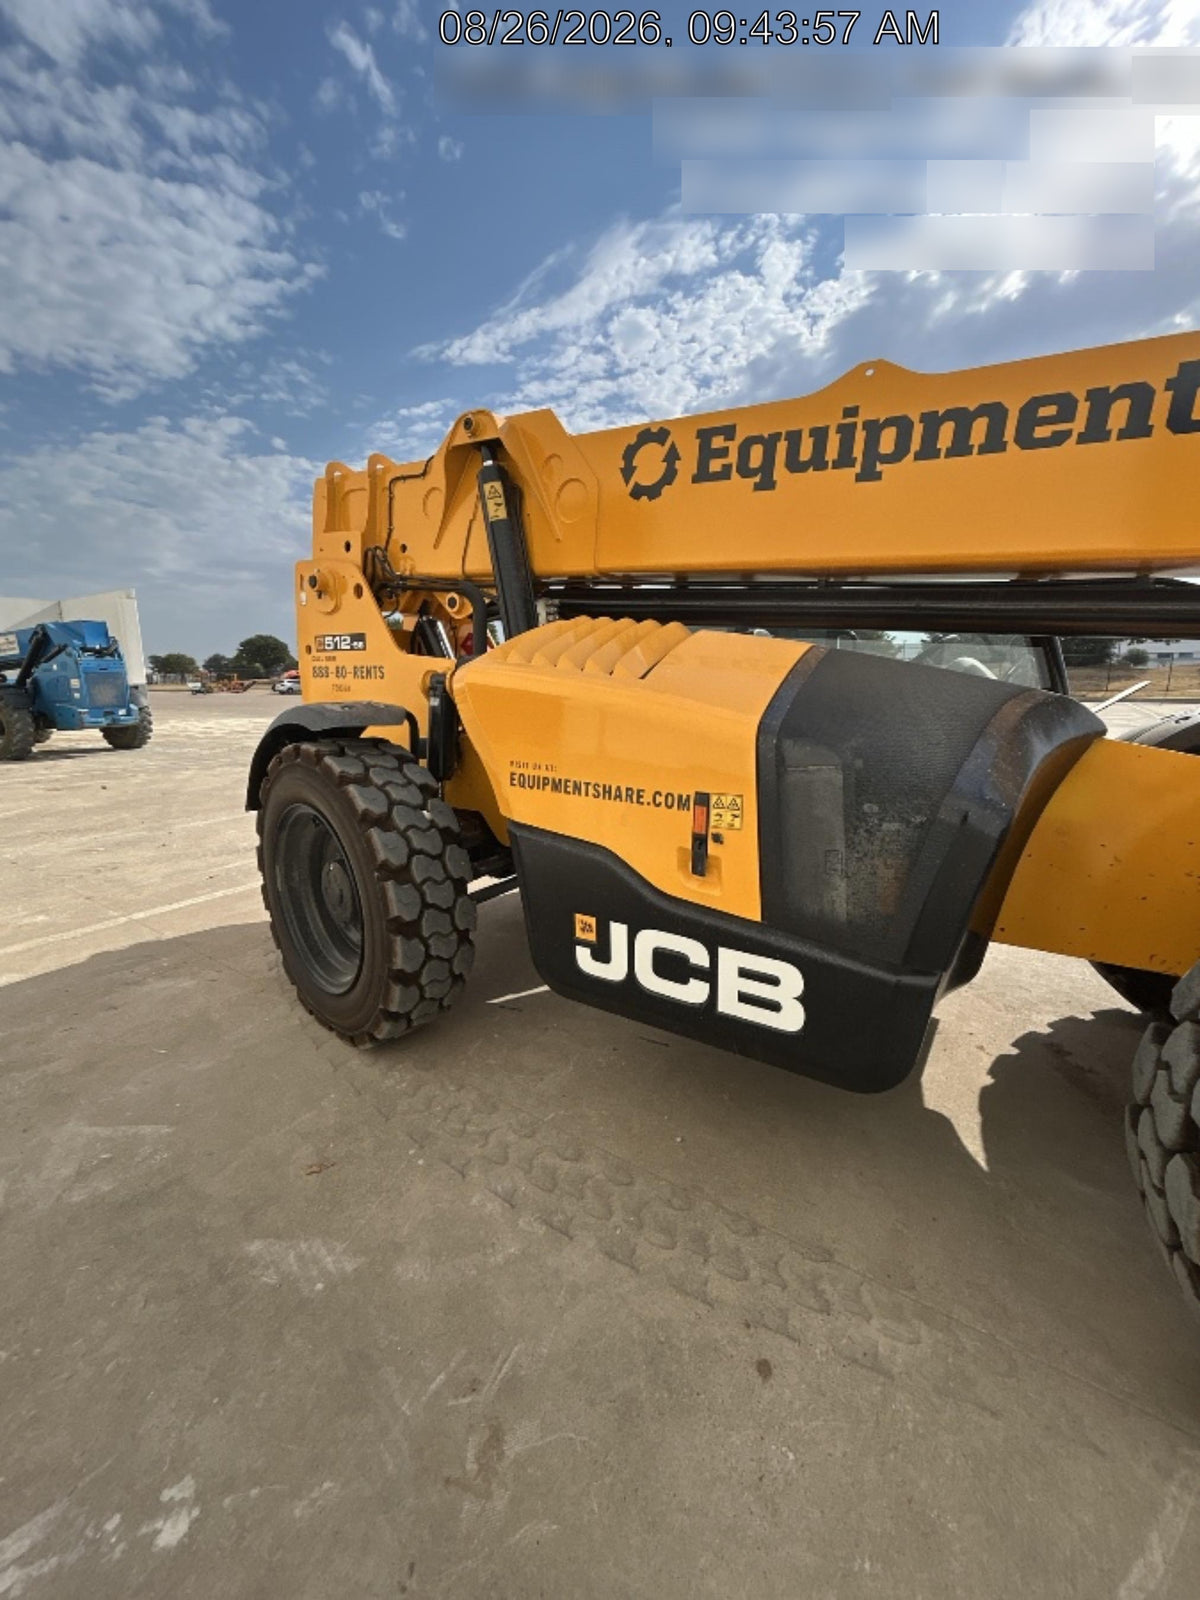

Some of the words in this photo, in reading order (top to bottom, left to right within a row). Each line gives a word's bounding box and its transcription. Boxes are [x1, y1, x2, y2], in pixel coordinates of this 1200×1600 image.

[691, 358, 1200, 492] Equipment
[509, 771, 691, 812] EQUIPMENTSHARE.COM
[574, 919, 806, 1033] JCB
